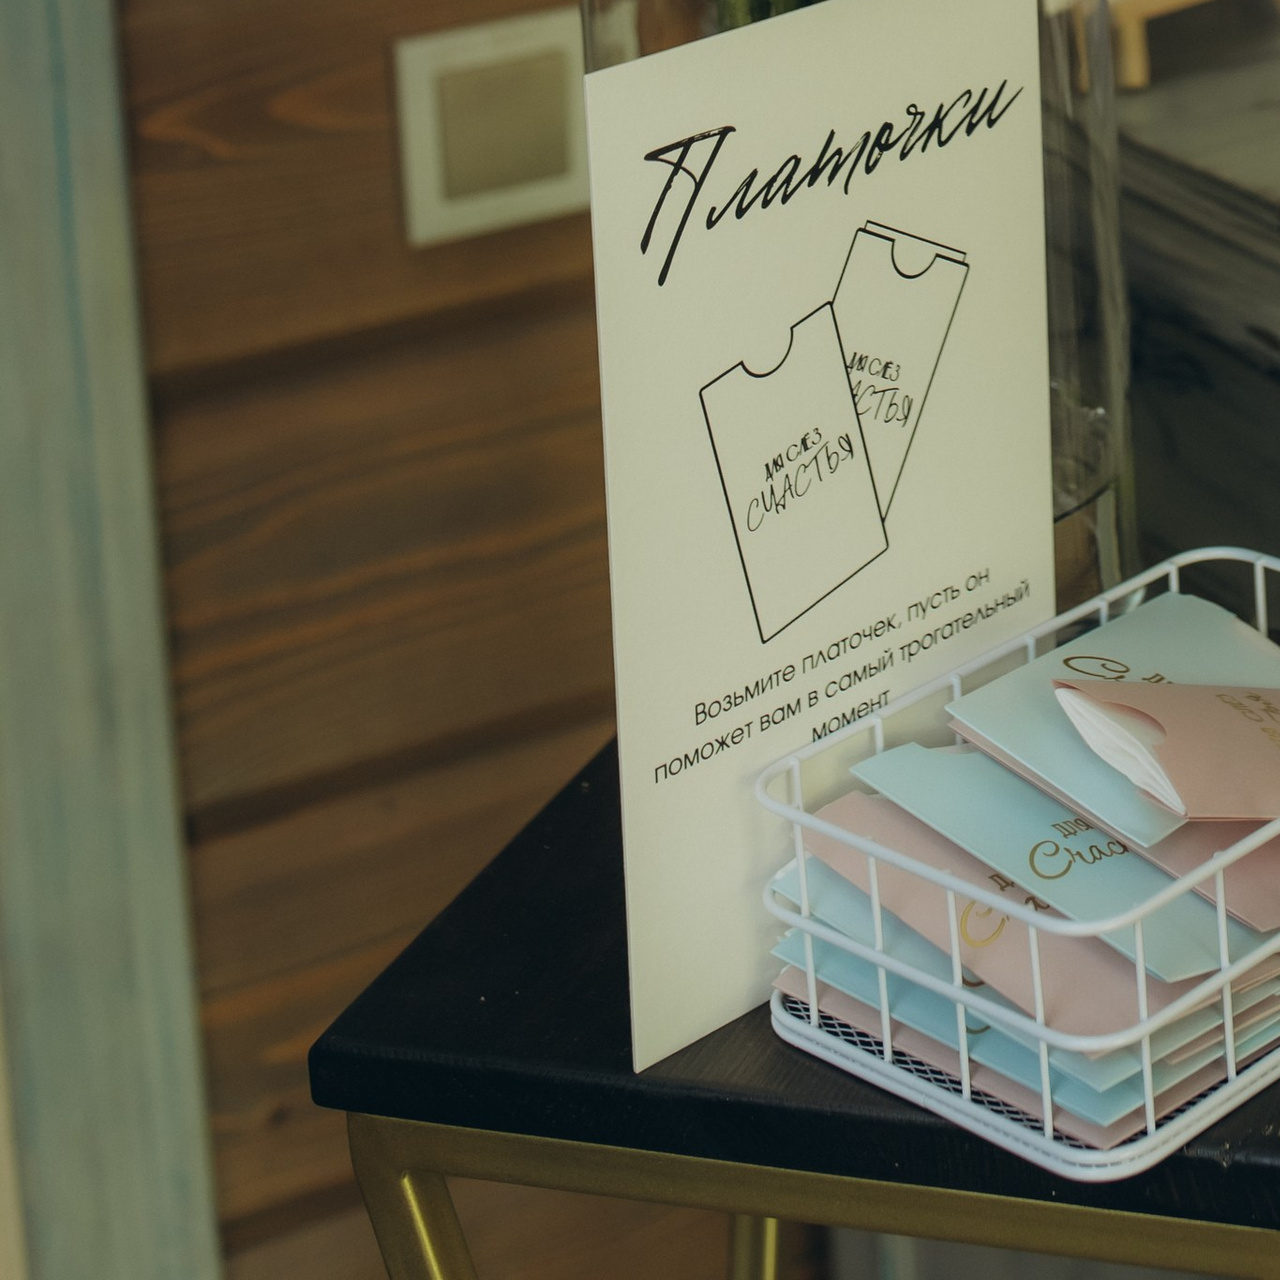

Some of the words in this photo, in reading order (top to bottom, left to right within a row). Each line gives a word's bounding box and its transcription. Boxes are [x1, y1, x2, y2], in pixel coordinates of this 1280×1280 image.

[640, 79, 1024, 287] Платочки
[747, 433, 854, 532] СЧАСТЬЯ
[654, 720, 753, 784] поможет
[759, 697, 802, 733] вам
[807, 690, 819, 708] в
[825, 647, 894, 699] самый
[899, 578, 1030, 663] трогательный
[694, 664, 796, 726] Возьмите
[802, 612, 902, 674] платочек,
[907, 585, 961, 623] пусть
[965, 568, 990, 593] он
[812, 690, 890, 743] момент
